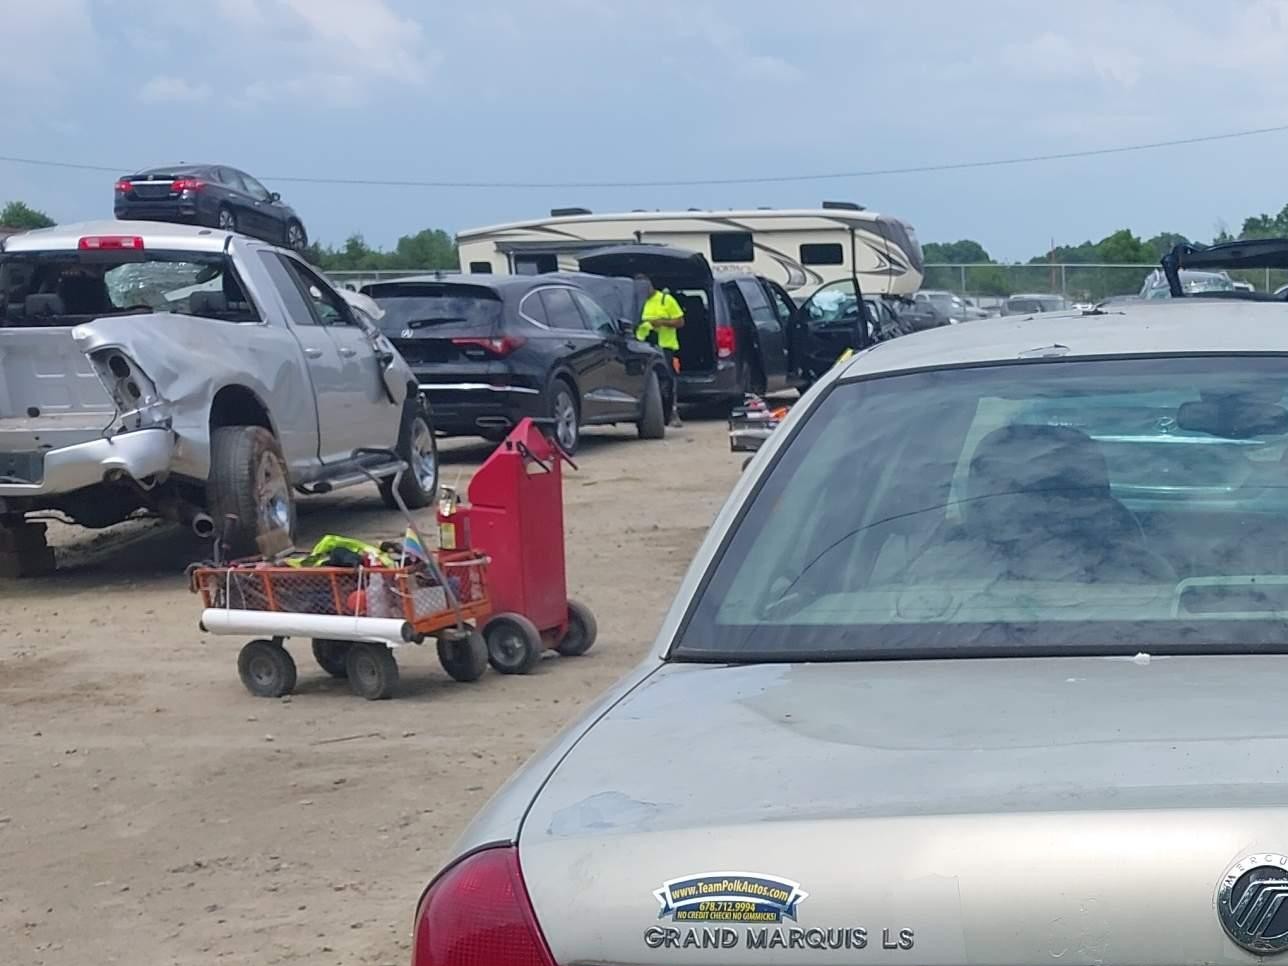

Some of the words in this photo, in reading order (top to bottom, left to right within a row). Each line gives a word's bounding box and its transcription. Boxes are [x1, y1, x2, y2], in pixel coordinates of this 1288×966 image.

[671, 880, 788, 901] www.TeamPolkAutos.com
[699, 902, 755, 912] 678.712.9994
[732, 912, 742, 920] NO
[644, 926, 739, 948] GRAND
[746, 927, 868, 949] MARQUIS
[882, 927, 914, 949] LS
